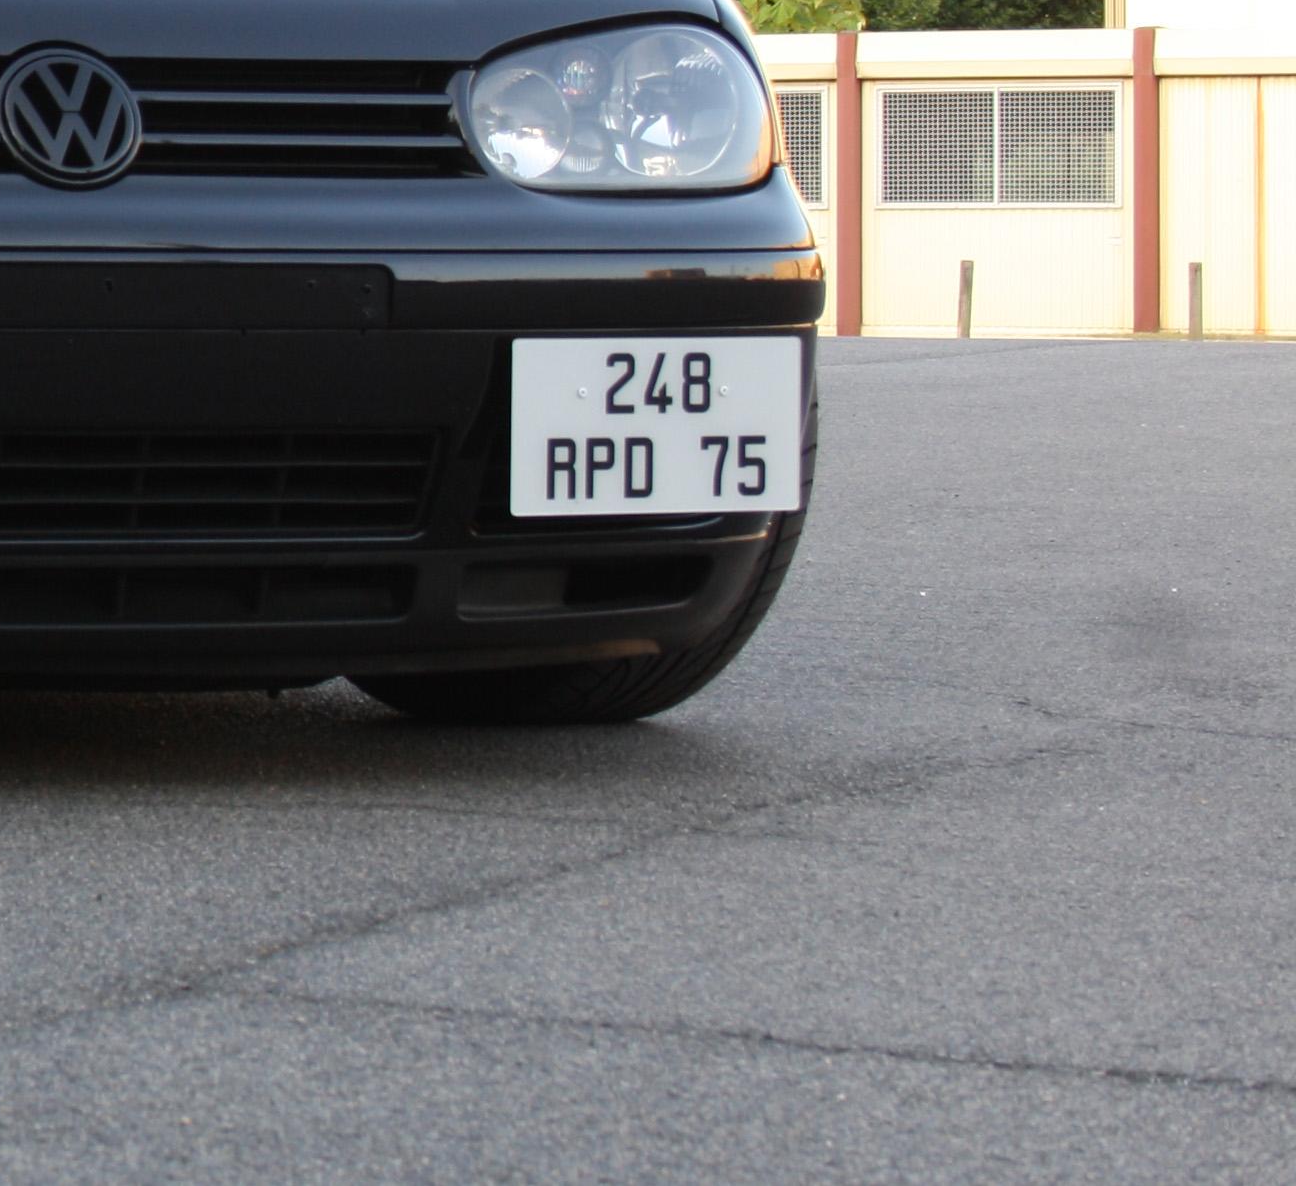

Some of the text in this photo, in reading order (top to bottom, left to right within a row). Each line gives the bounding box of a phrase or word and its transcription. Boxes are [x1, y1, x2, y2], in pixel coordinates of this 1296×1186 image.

[606, 352, 711, 414] 248
[546, 435, 767, 500] RPD 75
